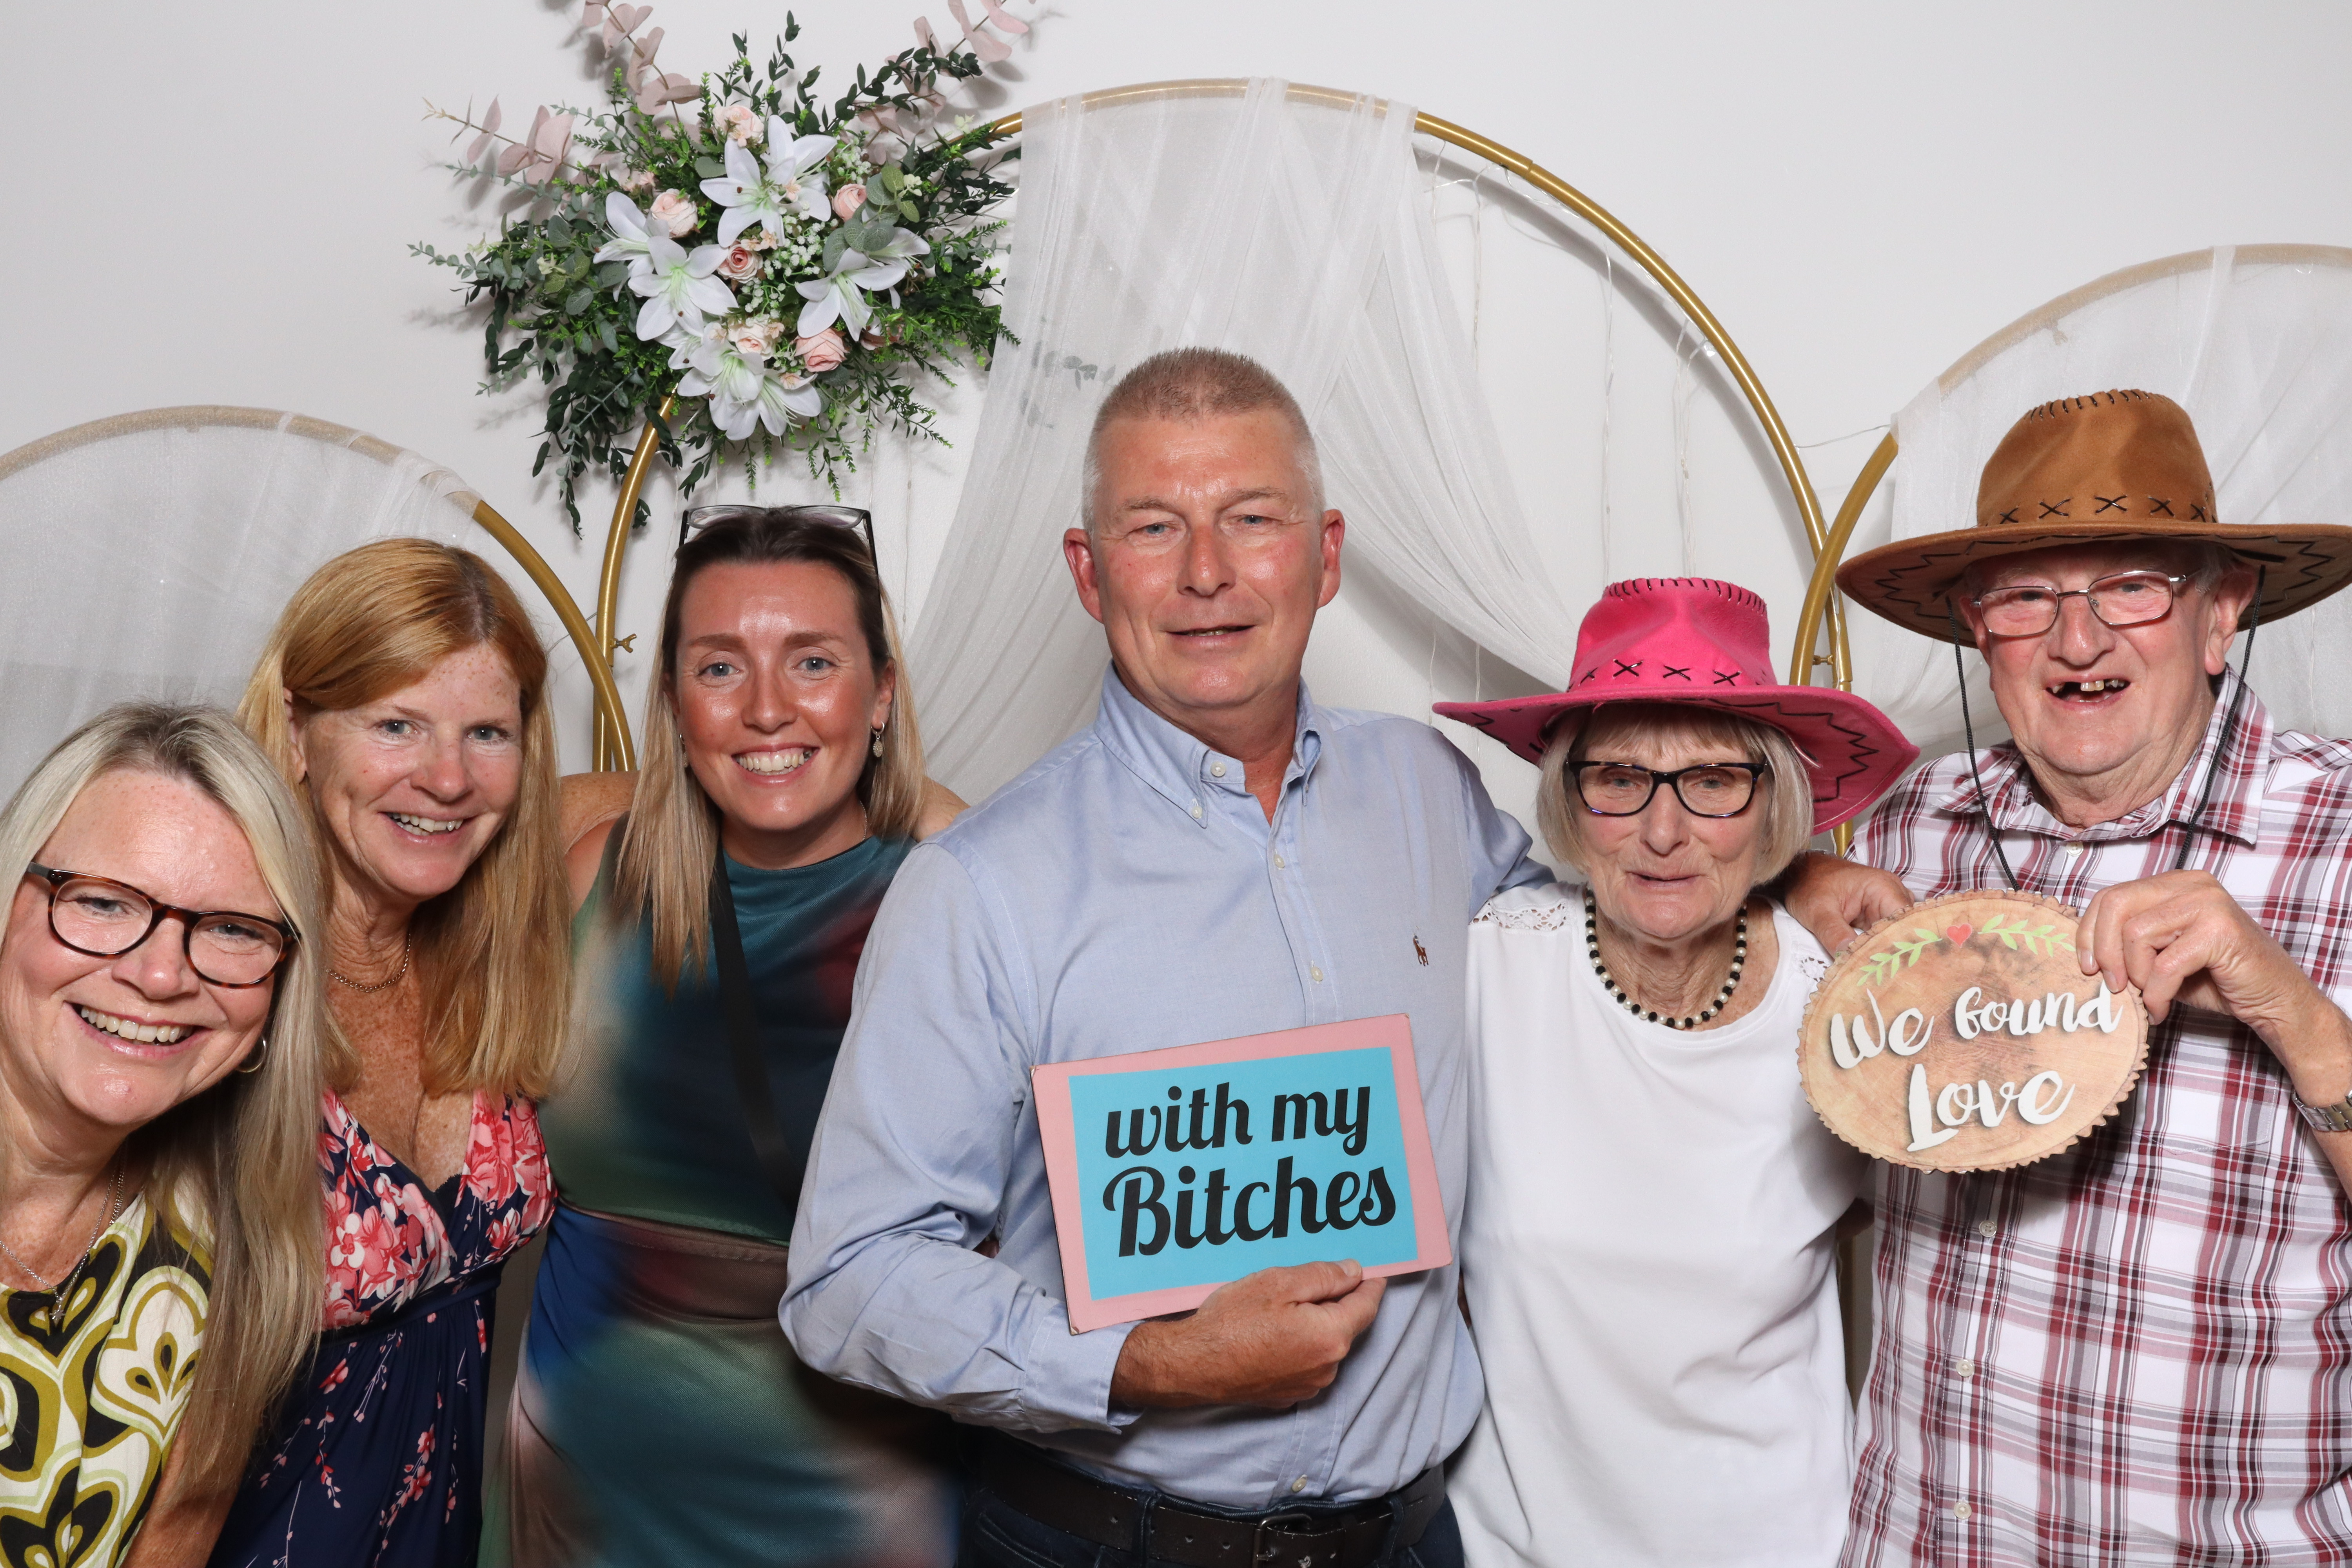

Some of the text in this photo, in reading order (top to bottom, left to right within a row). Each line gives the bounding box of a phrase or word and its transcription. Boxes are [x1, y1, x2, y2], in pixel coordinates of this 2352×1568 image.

[1831, 980, 2123, 1069] We found
[1105, 1082, 1370, 1158] with my
[1907, 1063, 2075, 1152] Love
[1103, 1156, 1396, 1258] Bitches
